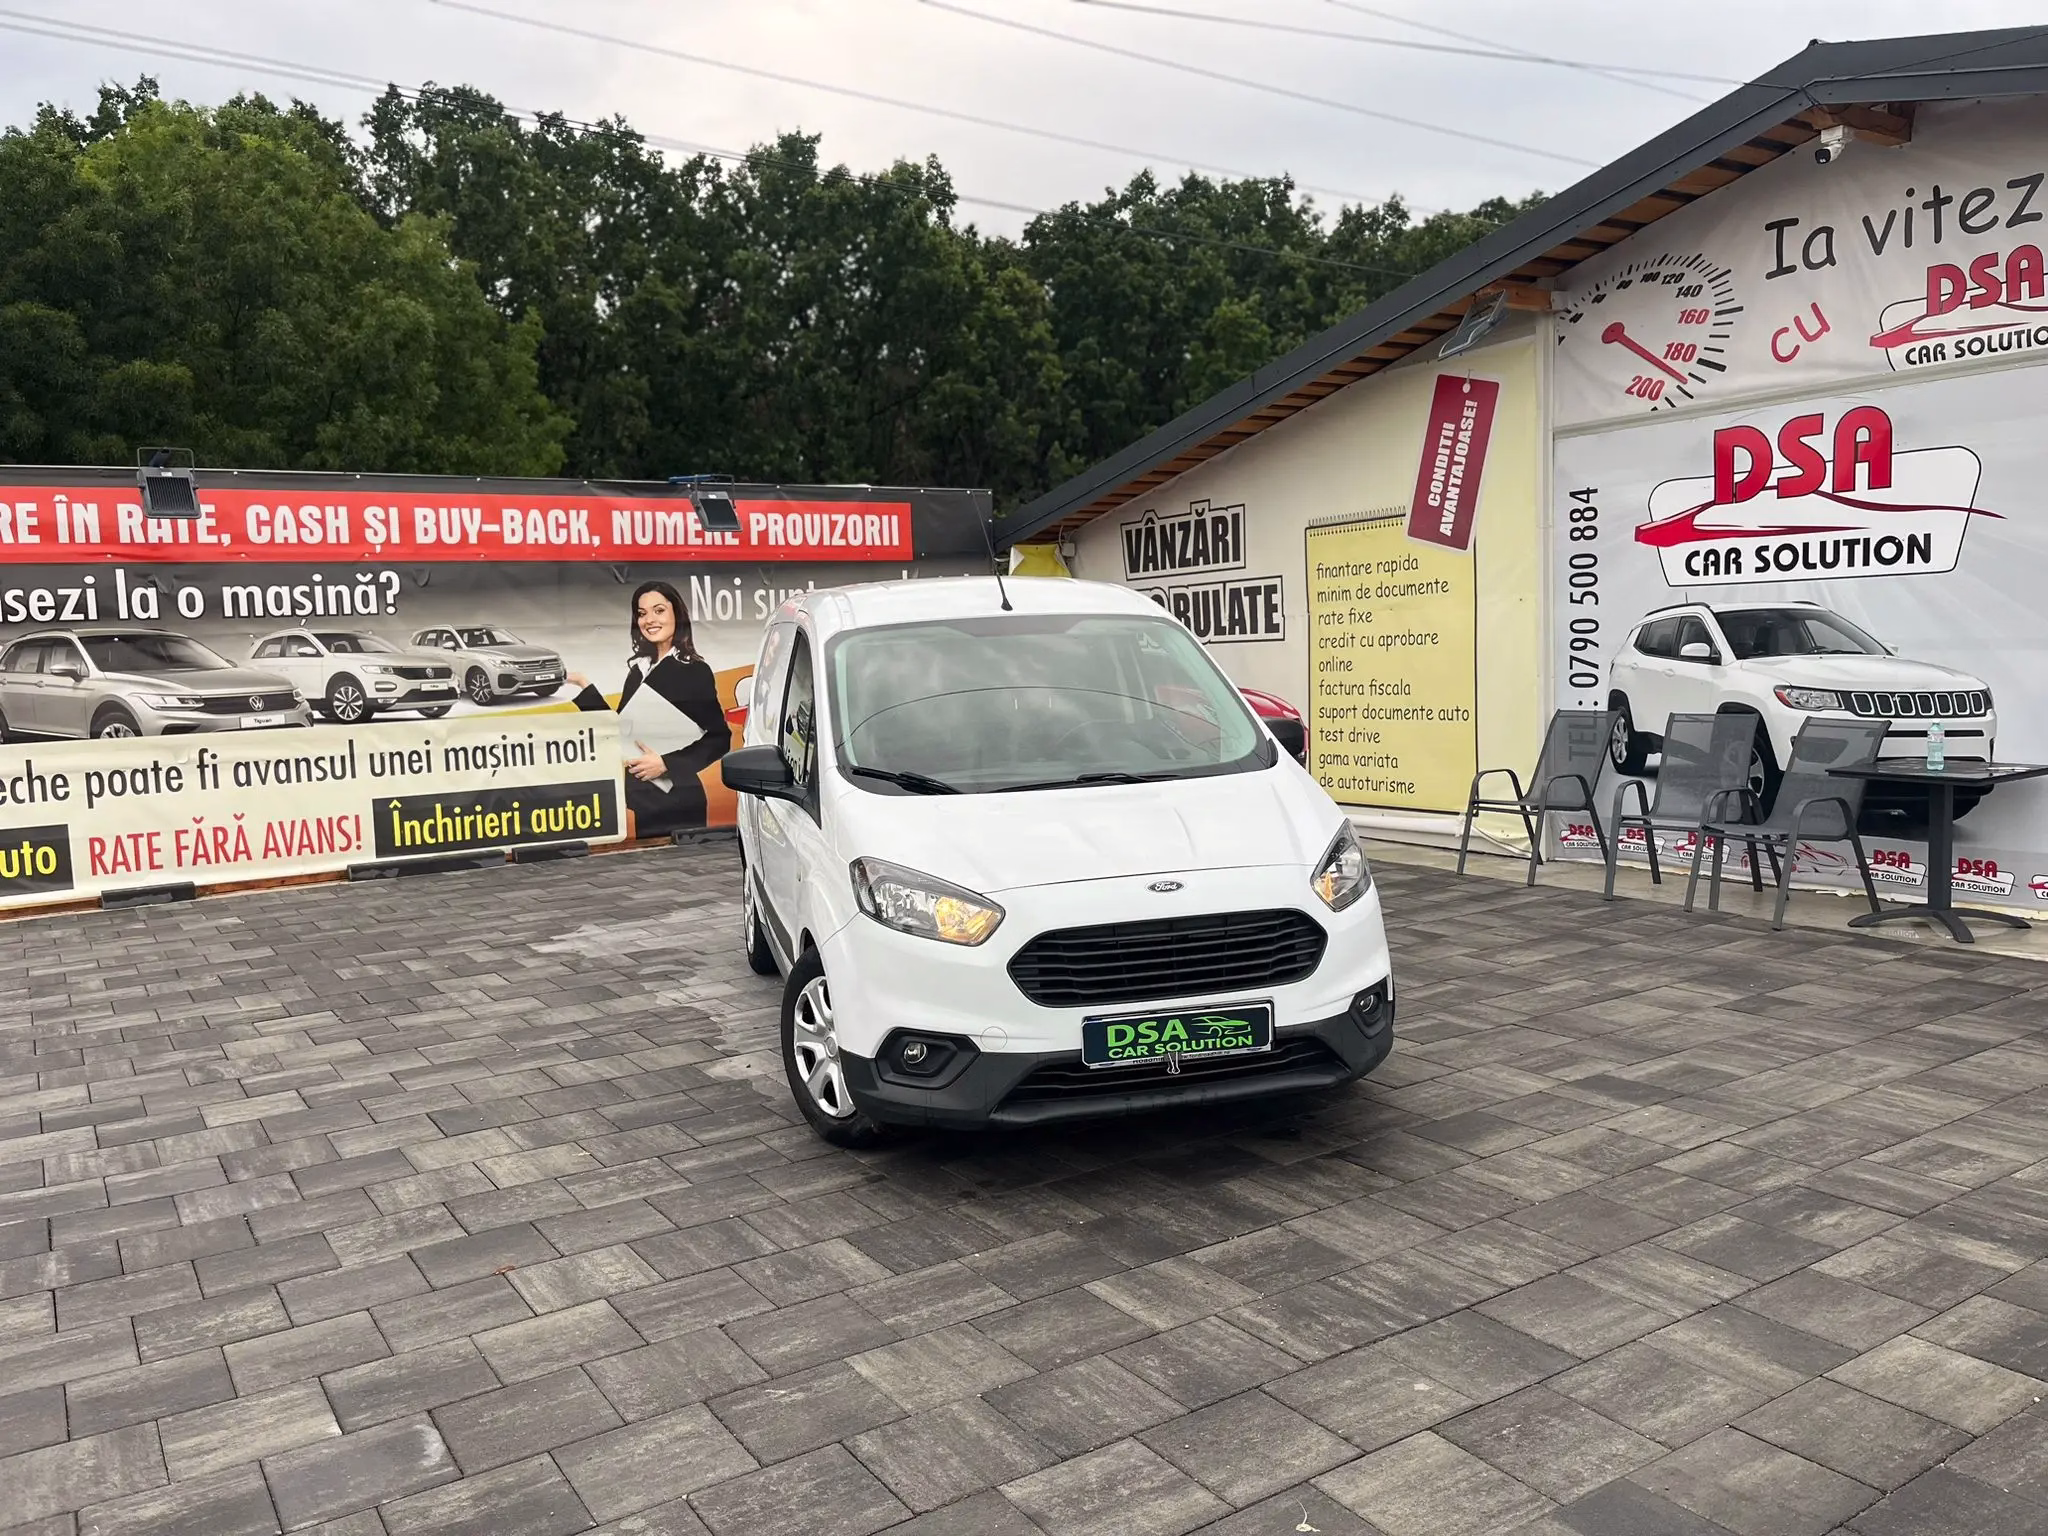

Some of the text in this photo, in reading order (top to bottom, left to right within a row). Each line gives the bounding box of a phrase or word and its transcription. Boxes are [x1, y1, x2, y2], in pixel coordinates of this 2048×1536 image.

[1862, 173, 2045, 256] vitez
[1640, 272, 1661, 283] 100
[1661, 273, 1685, 285] 120
[1926, 244, 2045, 317] DSA
[1676, 285, 1703, 298] 140
[1678, 309, 1710, 324] 160
[1771, 302, 1831, 363] cu
[1663, 343, 1697, 363] 180
[1905, 345, 1947, 365] CAR
[1625, 376, 1665, 401] 200
[1427, 422, 1455, 507] CONDITII
[1714, 405, 1893, 505] DSA
[1439, 400, 1477, 537] AVANTAJOASE!
[53, 494, 101, 544] ÎN
[245, 504, 350, 544] CASH
[414, 507, 600, 548] BUY-BACK,
[749, 512, 900, 547] PROVIZORII
[1569, 487, 1599, 542] 884
[1125, 508, 1241, 574] VÂNZĂRI
[1316, 553, 1419, 580] finantare rapida
[1685, 532, 1932, 577] CAR SOLUTION
[1317, 578, 1449, 603] minim de documente
[1568, 552, 1599, 605] 500
[0, 575, 99, 623] sezi
[115, 568, 160, 620] la
[177, 586, 205, 619] o
[690, 575, 742, 621] Noi
[1318, 607, 1373, 626] rate fixe
[1318, 628, 1439, 652] credit cu aprobare
[1568, 617, 1600, 688] 0790
[1318, 656, 1353, 673] online
[1319, 678, 1411, 697] factura fiscala
[1318, 703, 1470, 724] suport documente auto
[1319, 727, 1381, 744] test drive
[85, 760, 184, 809] poate
[197, 747, 220, 790] fi
[233, 739, 357, 788] avansul
[369, 739, 433, 778] unei
[444, 734, 535, 778] mașini
[546, 727, 596, 765] noi!
[1318, 752, 1399, 770] gama variata
[1319, 772, 1416, 795] de autoturisme
[388, 793, 602, 847] Închirieri auto!
[88, 813, 362, 876] RATE FĂRĂ AVANS!
[1873, 849, 1910, 869] DSA
[1958, 858, 1998, 878] DSA
[1154, 880, 1178, 891] Ford
[1881, 873, 1917, 884] SOLUTION
[1967, 882, 2006, 894] SOLUTION
[1106, 1018, 1189, 1048] DSA
[1108, 1045, 1149, 1059] CAR
[1154, 1035, 1253, 1055] SOLUTION
